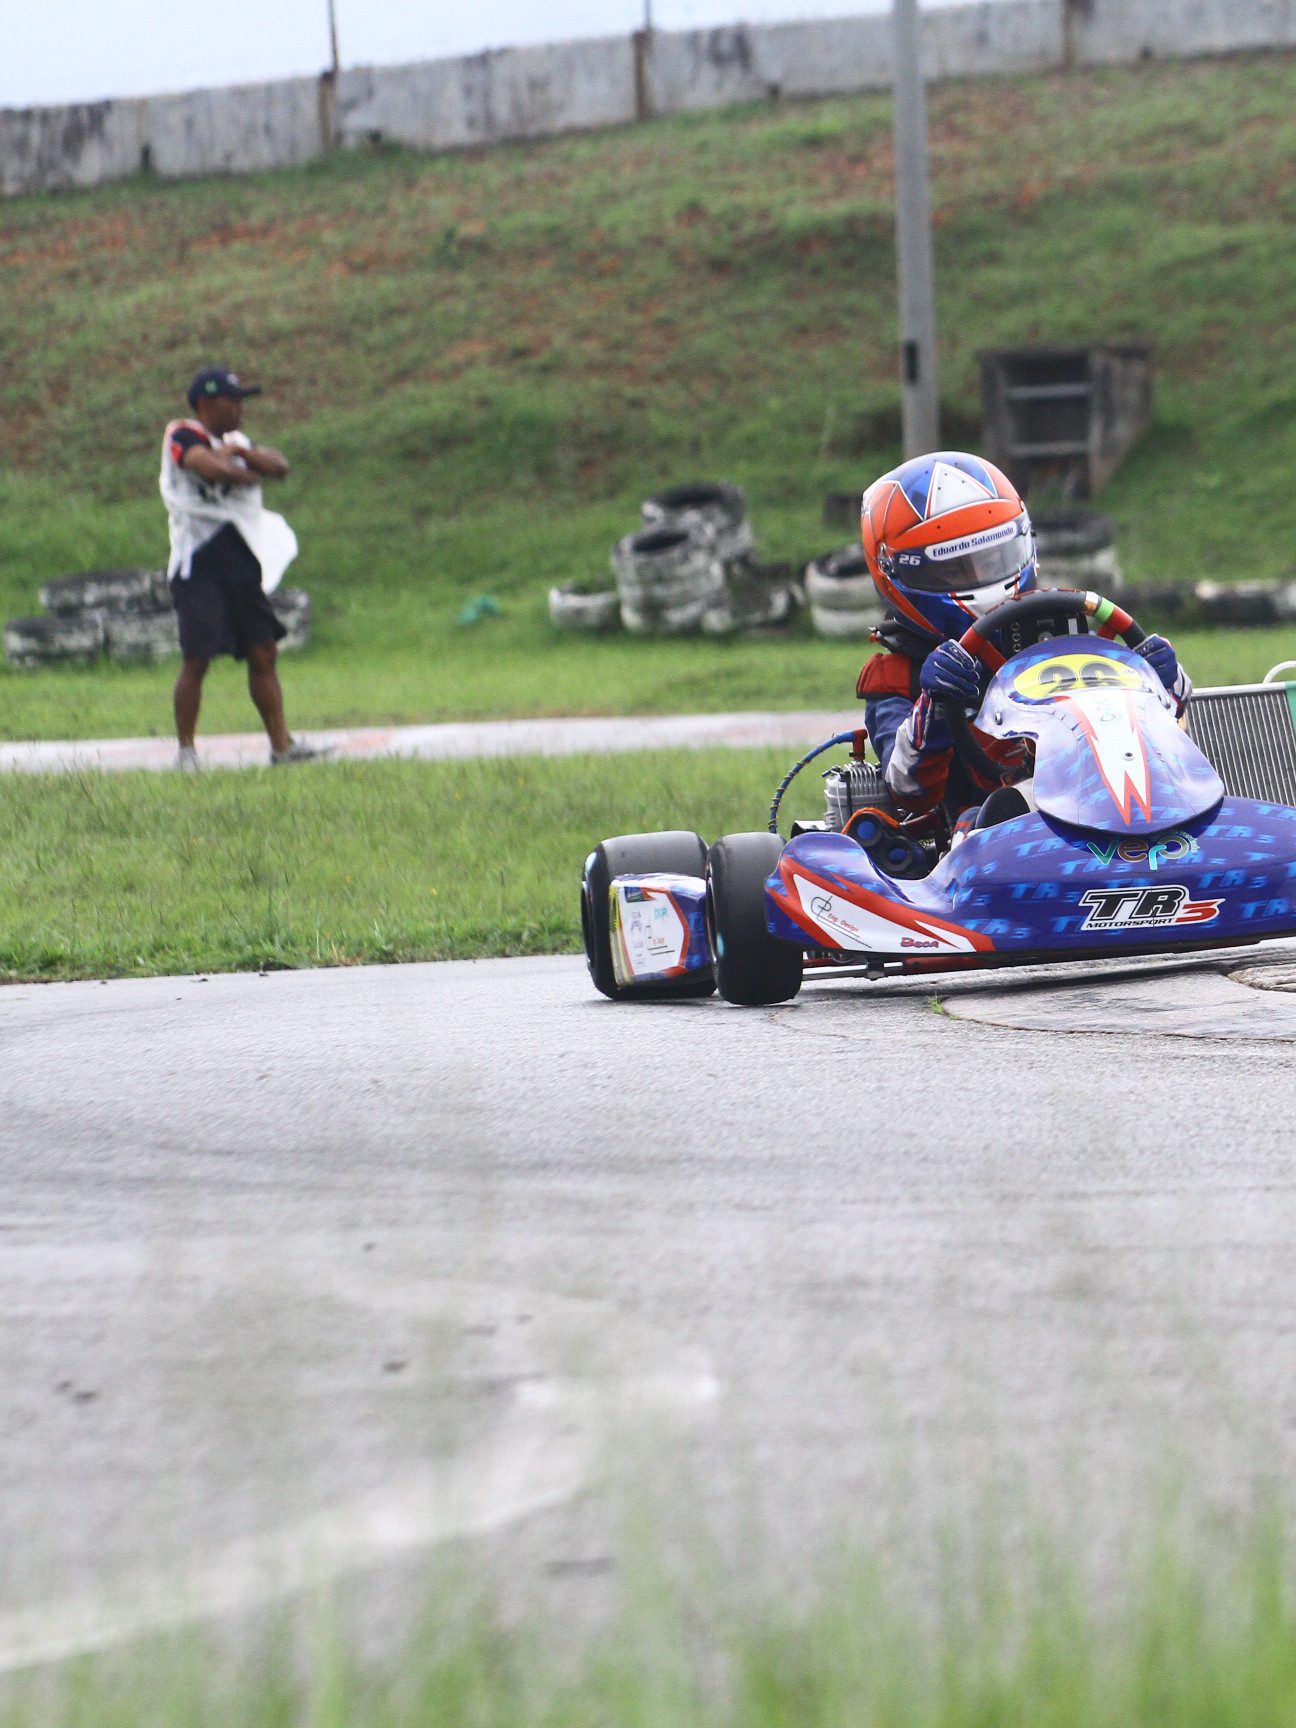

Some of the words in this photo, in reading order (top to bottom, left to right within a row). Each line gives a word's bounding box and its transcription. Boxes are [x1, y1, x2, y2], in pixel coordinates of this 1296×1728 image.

[933, 542, 970, 557] Eduardo
[899, 553, 921, 566] 26
[1086, 918, 1174, 928] MOTORSPORT
